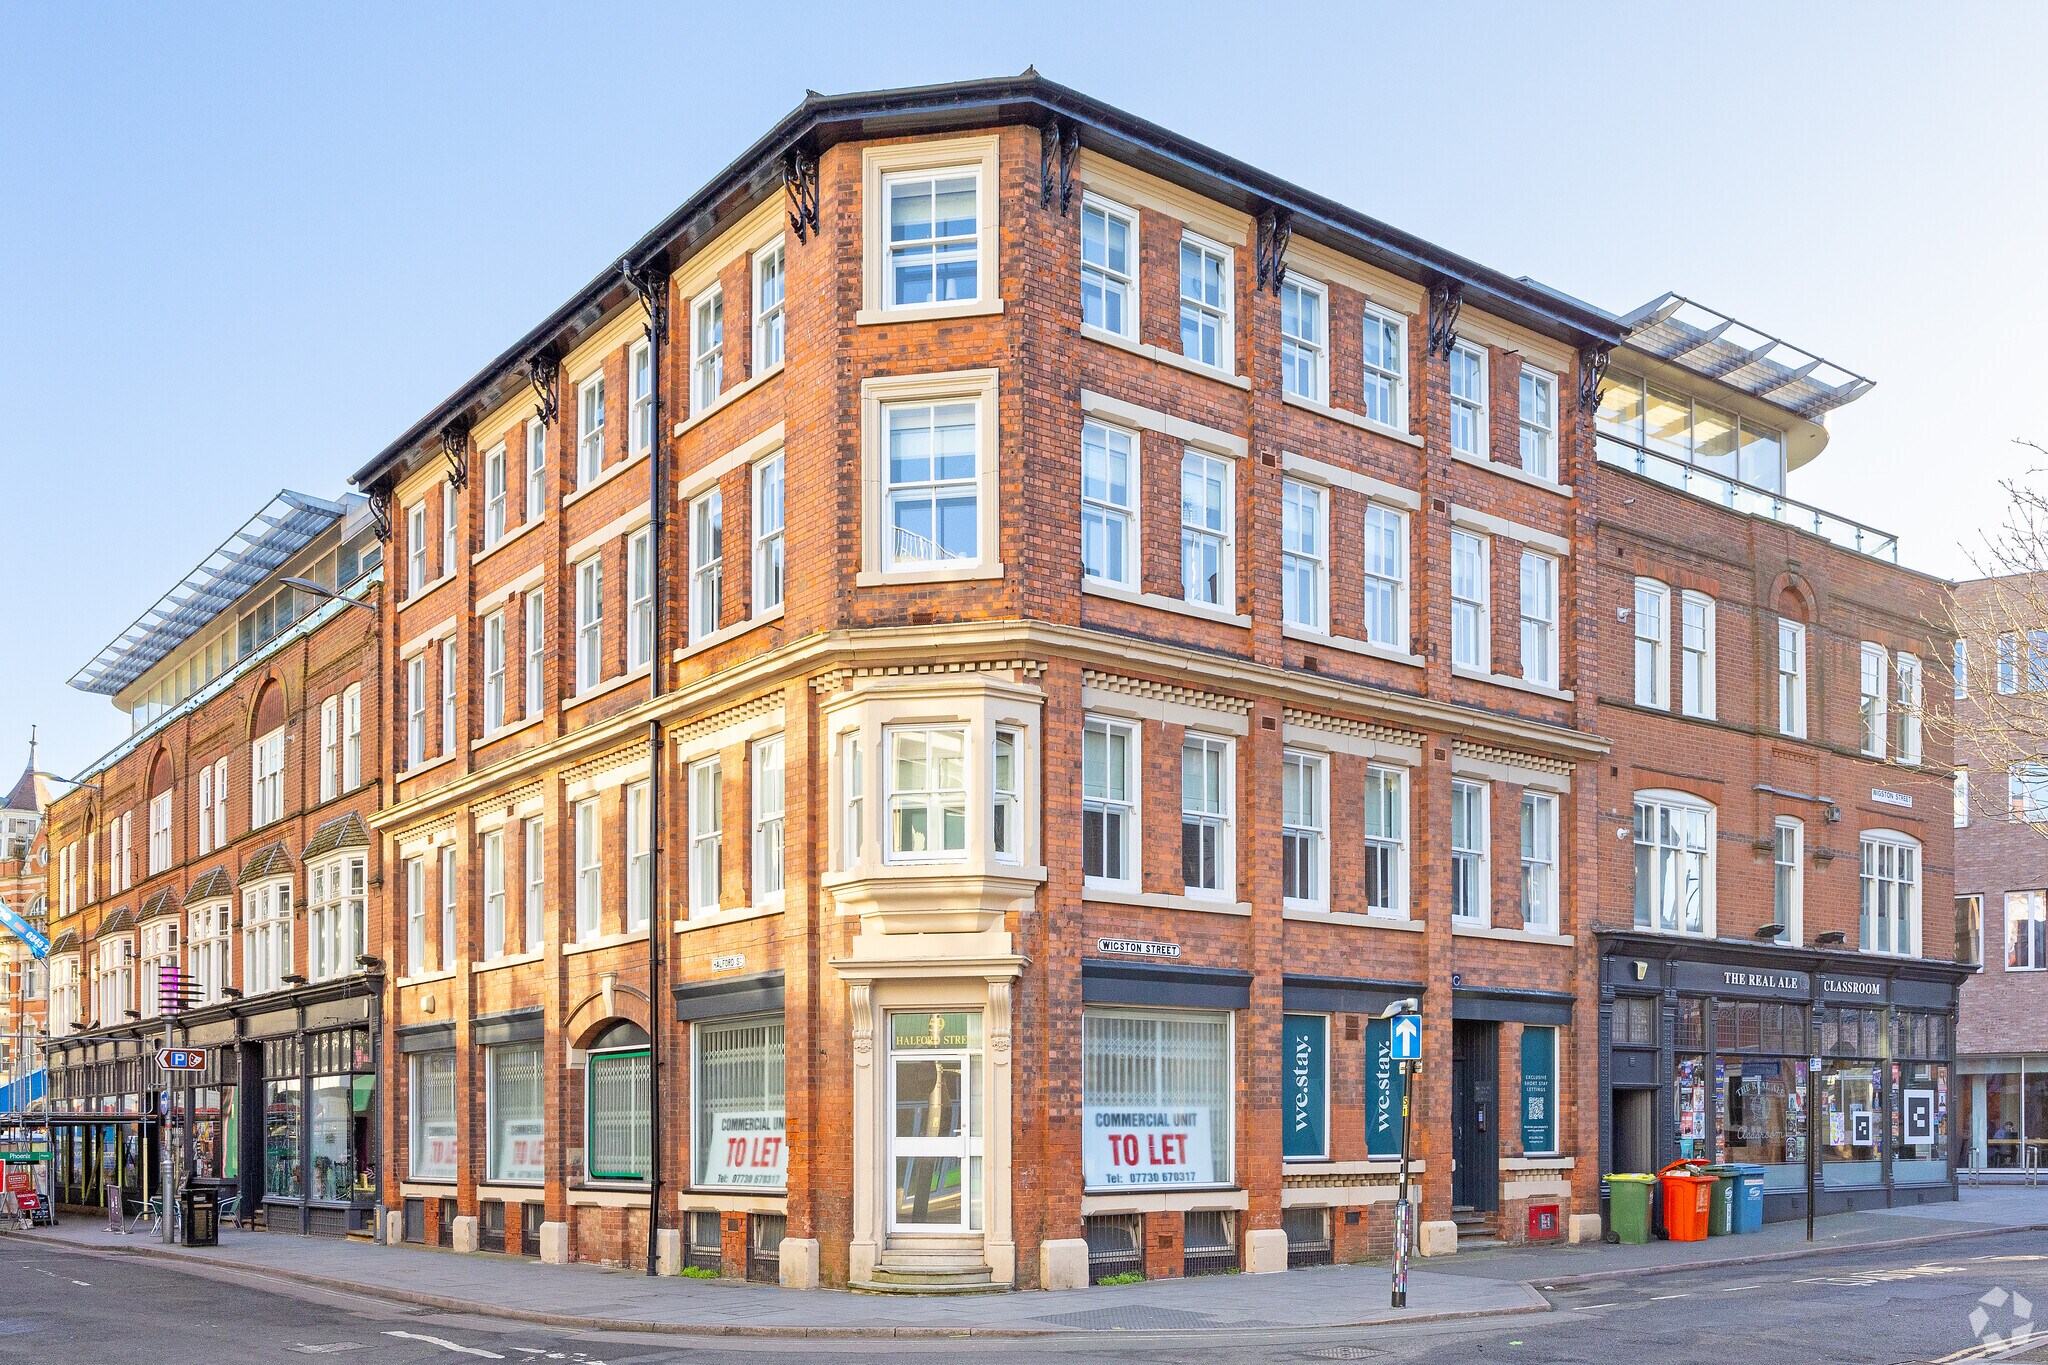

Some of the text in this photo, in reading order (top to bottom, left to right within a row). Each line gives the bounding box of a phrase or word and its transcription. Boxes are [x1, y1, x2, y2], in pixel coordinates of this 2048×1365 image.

[1146, 944, 1177, 955] STREET
[1724, 972, 1880, 995] THE REAL ALE CLASSROOM
[896, 1035, 978, 1046] HALFORD STRE
[1293, 1035, 1312, 1132] we.stay.
[1752, 1082, 1769, 1090] RAL
[721, 1117, 771, 1131] COMMERCIAL
[1095, 1113, 1198, 1128] COMMERCIAL UNIT
[727, 1137, 782, 1167] TO LET
[1108, 1134, 1188, 1166] TO LET
[1106, 1173, 1123, 1183] Tel:
